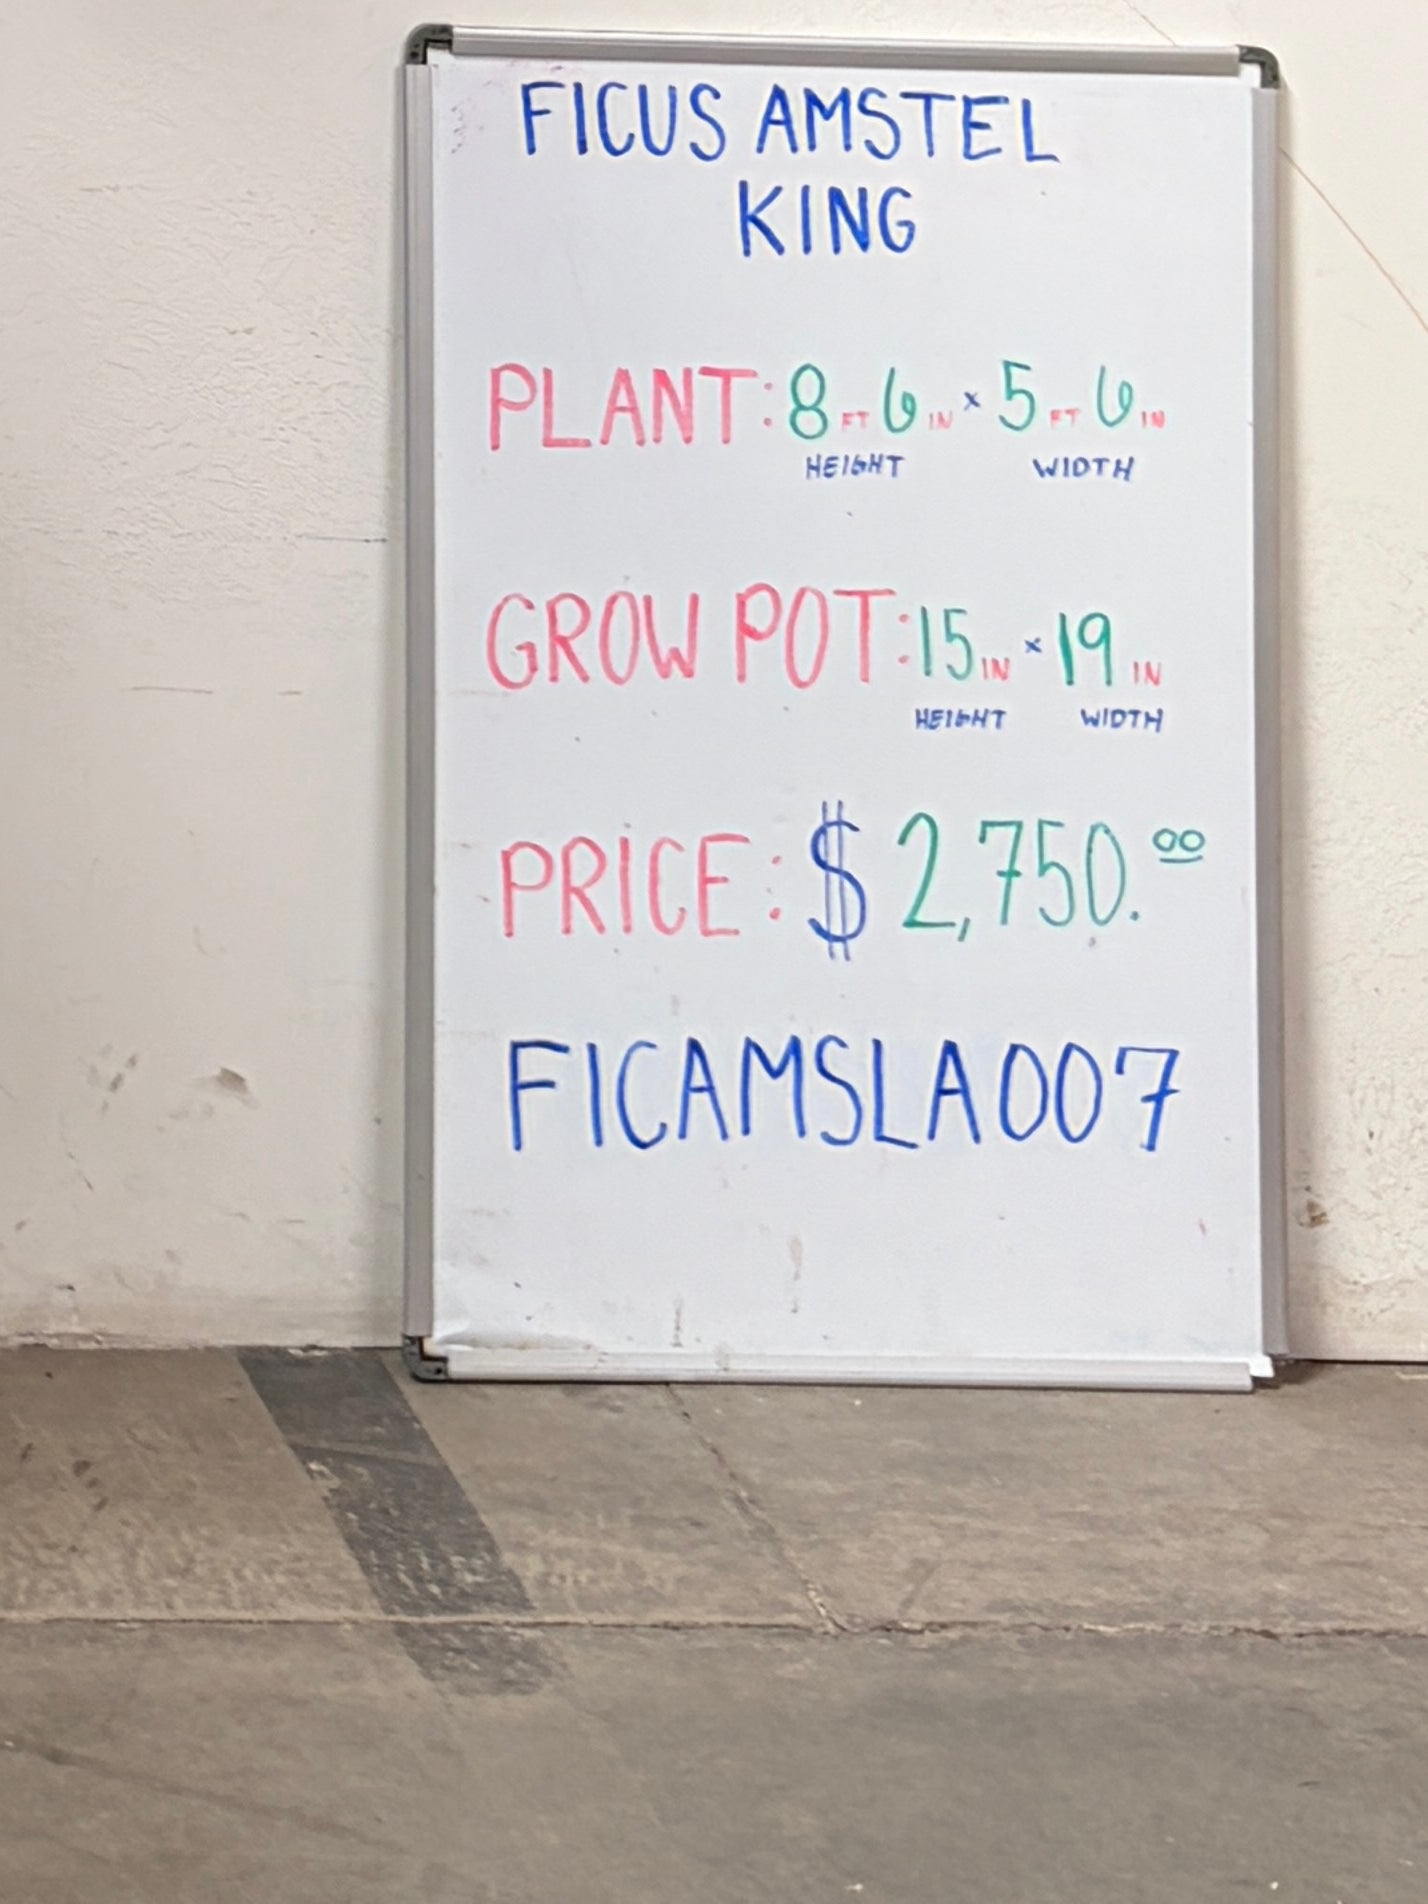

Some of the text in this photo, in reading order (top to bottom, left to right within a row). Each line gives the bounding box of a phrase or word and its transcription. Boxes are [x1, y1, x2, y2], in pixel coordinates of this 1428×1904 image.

[520, 81, 1060, 162] FICUS AMSTEL
[739, 180, 916, 257] KING
[489, 363, 772, 451] PLANT:
[789, 363, 829, 440] 8
[883, 367, 917, 434] 6
[999, 360, 1036, 432] 5
[1097, 366, 1134, 428] 6
[806, 454, 1134, 482] HEIGHT WIDTH
[487, 591, 699, 689] GROW
[736, 583, 908, 689] POT:
[921, 606, 974, 681] 15
[1058, 612, 1112, 687] 19
[915, 708, 1163, 733] HEIGHT WIDTH
[509, 1035, 1180, 1152] FICAMSLA007
